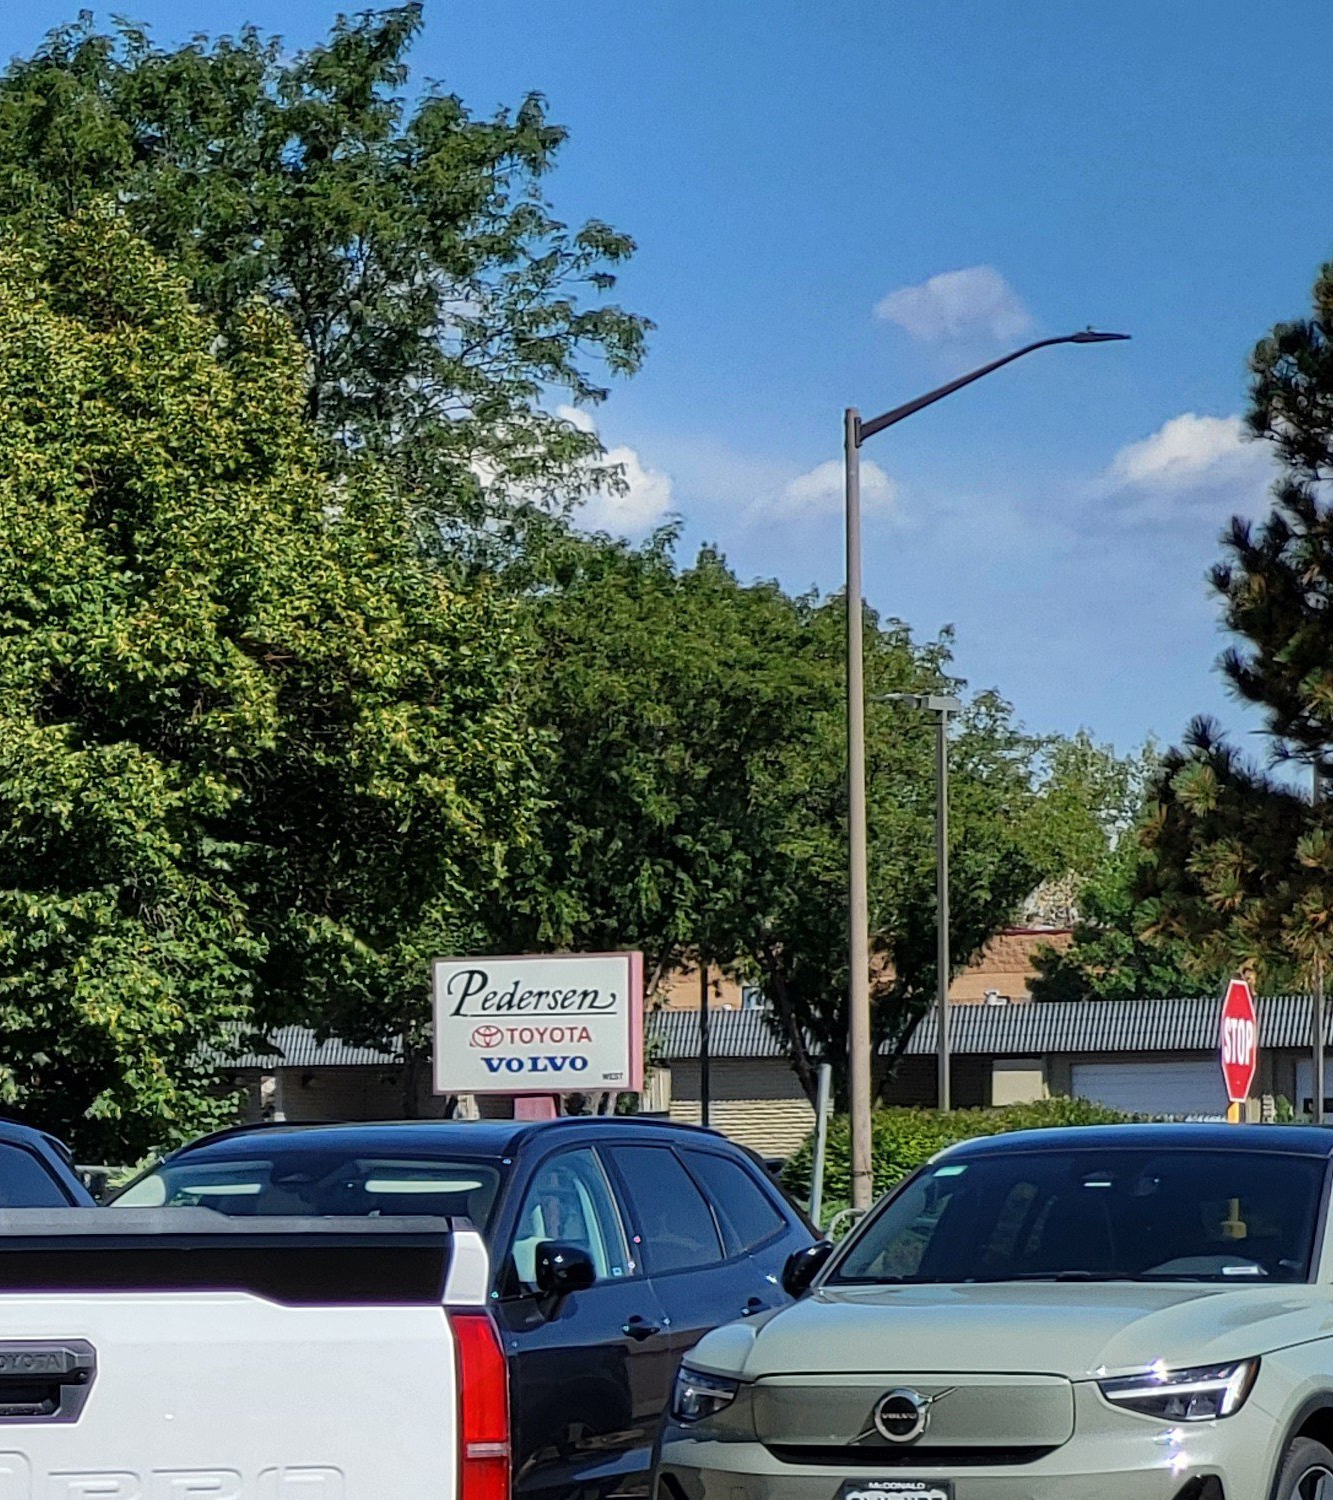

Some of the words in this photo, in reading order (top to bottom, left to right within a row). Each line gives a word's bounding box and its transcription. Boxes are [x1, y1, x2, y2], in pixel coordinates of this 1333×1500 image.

[447, 969, 617, 1017] Pedersen
[506, 1026, 592, 1044] TOYOTA
[1224, 1016, 1253, 1065] STOP
[480, 1055, 588, 1073] VOLVO
[881, 1412, 917, 1420] VOLVO
